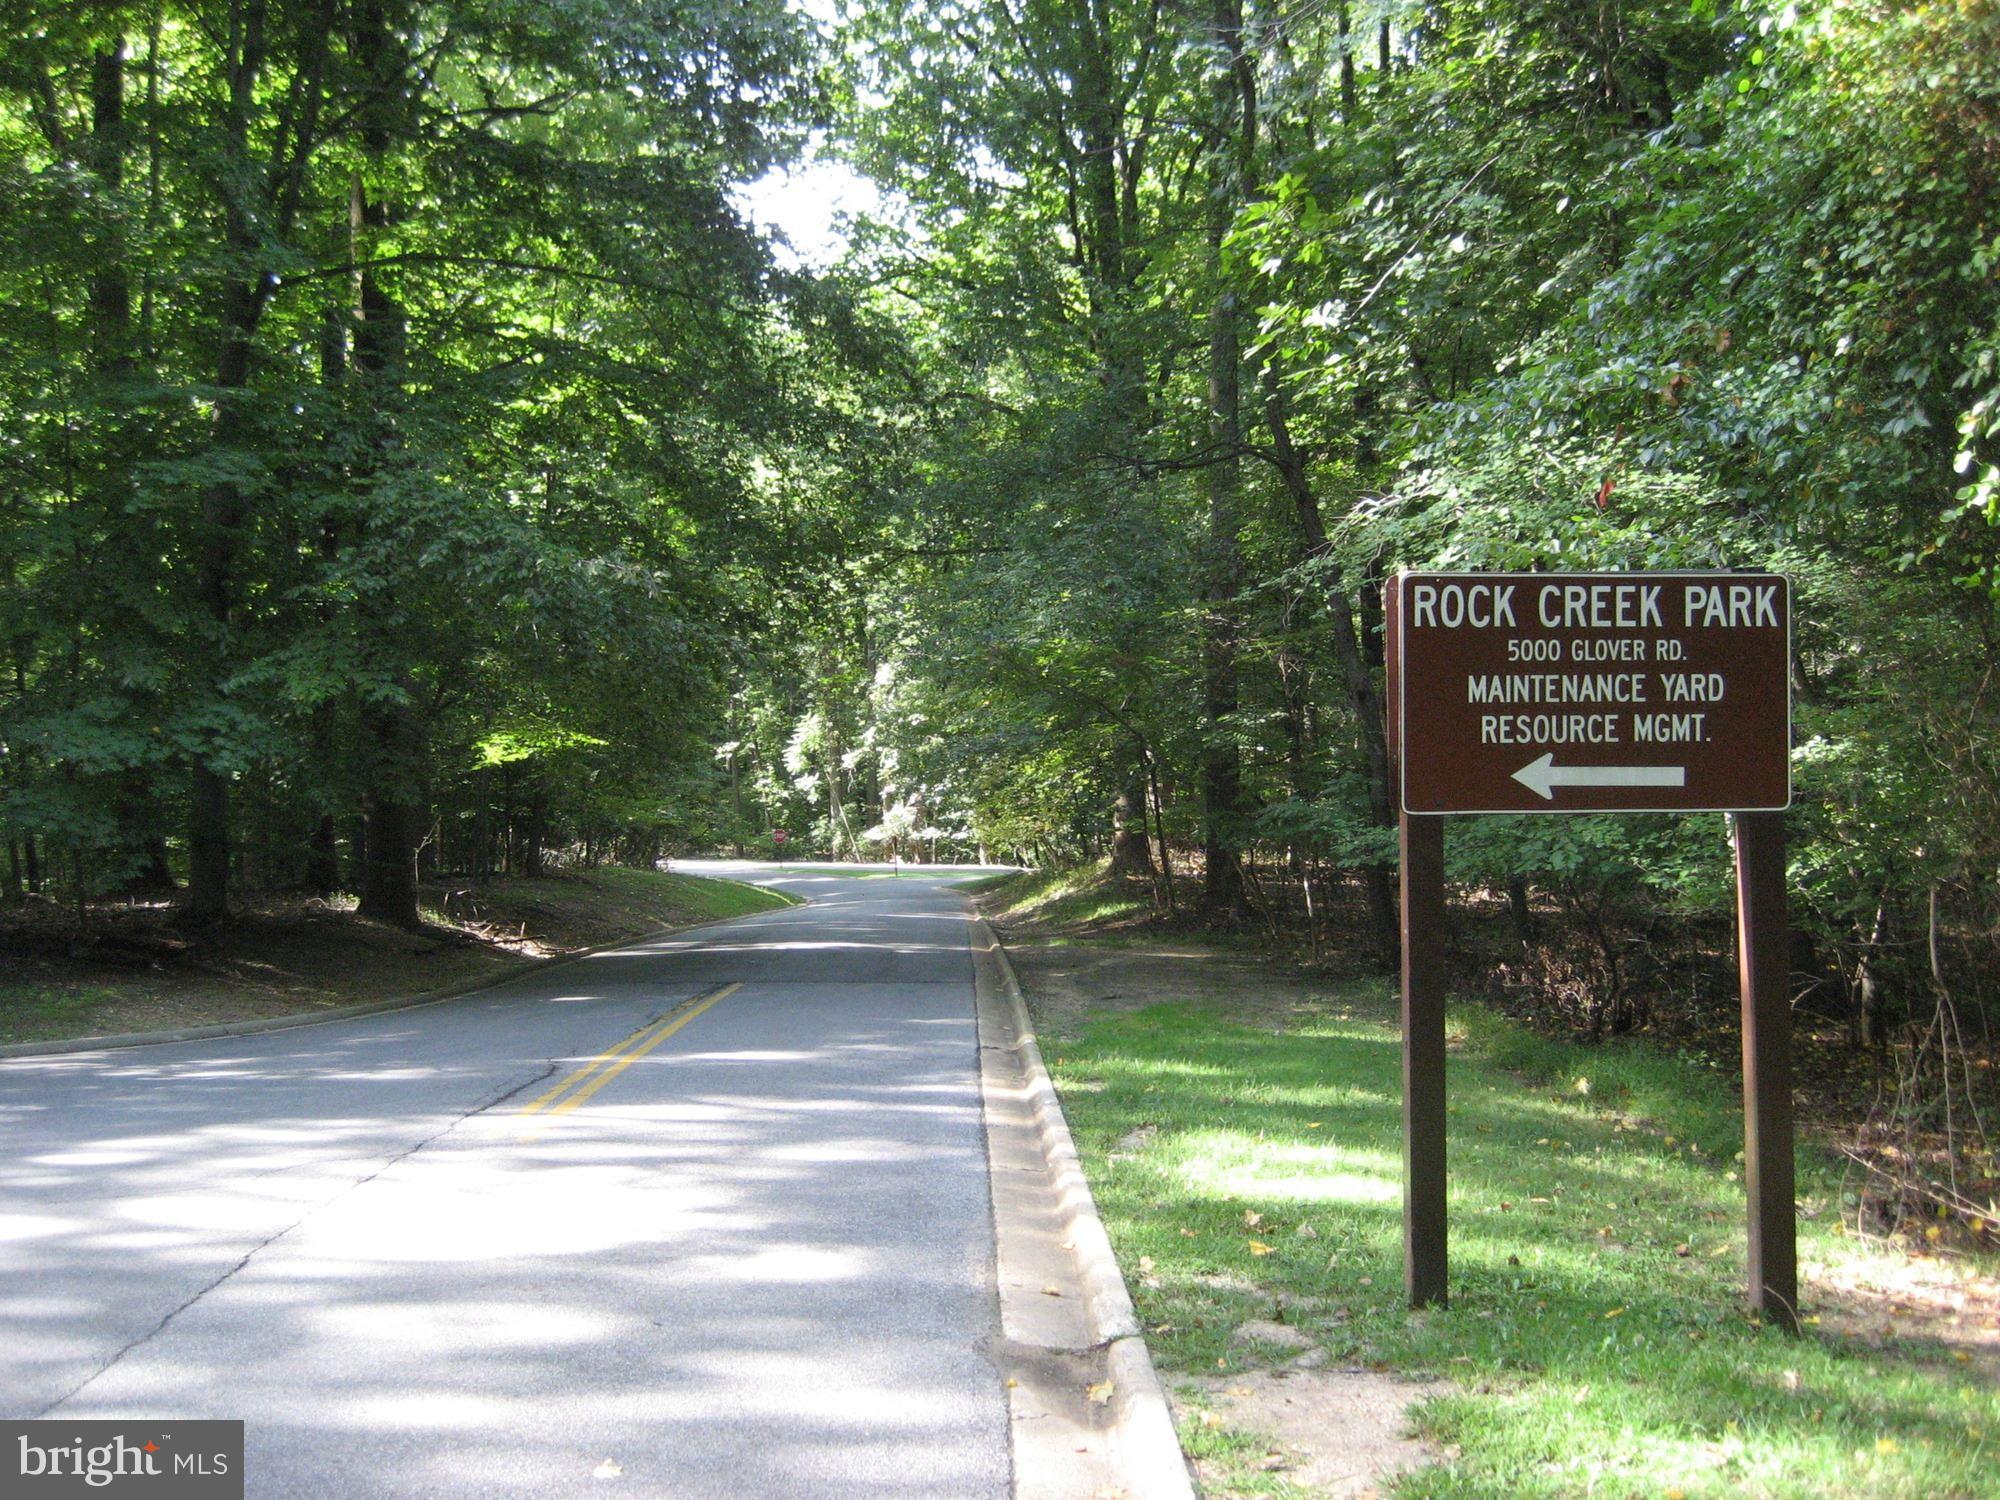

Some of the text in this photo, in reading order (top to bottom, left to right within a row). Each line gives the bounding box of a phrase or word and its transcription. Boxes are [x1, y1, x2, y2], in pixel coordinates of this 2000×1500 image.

[1414, 584, 1778, 627] ROCK CREEK PARK
[1508, 639, 1687, 661] 5000 GLOVER RD.
[1468, 673, 1724, 702] MAINTENANCE YARD
[1481, 713, 1711, 743] RESOURCE MGMT.
